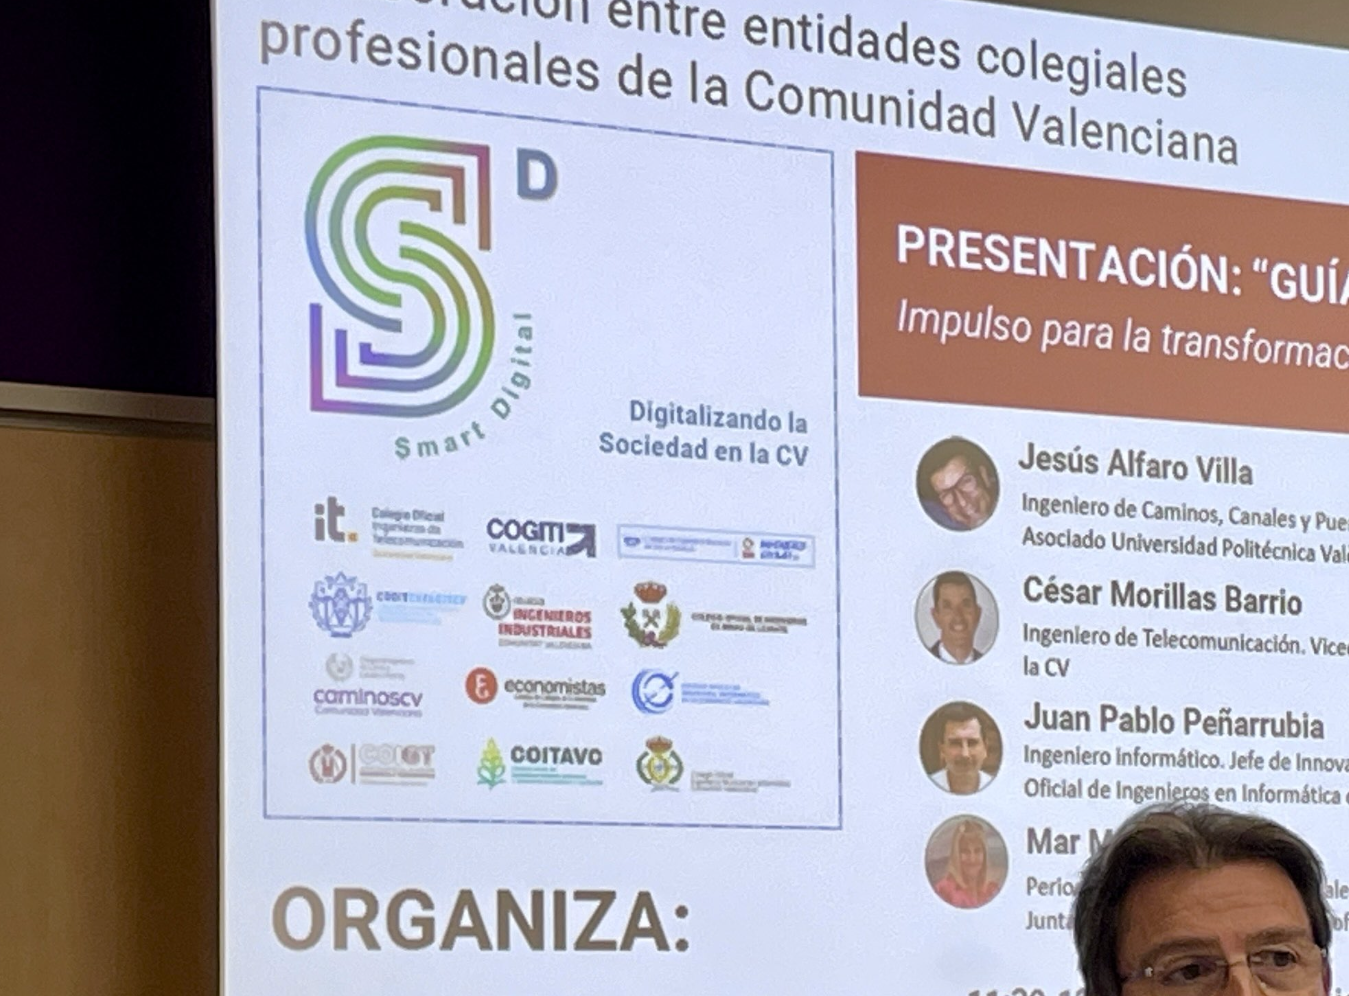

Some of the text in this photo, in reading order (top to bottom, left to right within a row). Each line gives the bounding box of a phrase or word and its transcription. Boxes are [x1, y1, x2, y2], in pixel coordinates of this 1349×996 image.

[607, 0, 727, 40] entre
[744, 13, 960, 70] entidades
[977, 38, 1186, 98] colegiales
[260, 18, 1238, 165] profesionales de la Comunidad Valenciana
[516, 147, 558, 201] D
[898, 224, 1241, 295] PRESENTACIÓN:
[898, 299, 1031, 344] Impulso
[1041, 320, 1113, 353] para
[1124, 317, 1150, 352] la
[394, 421, 486, 461] Smart
[490, 312, 534, 421] Digital
[630, 400, 807, 434] Digitalizando la
[599, 432, 809, 466] Sociedad en la CV
[1018, 442, 1253, 485] Jesús Alfaro Villa
[1022, 493, 1109, 517] Ingeniero
[1114, 498, 1137, 518] de
[1142, 501, 1223, 526] Caminos,
[1229, 506, 1296, 529] Canales
[1300, 515, 1311, 533] y
[1022, 526, 1106, 549] Asociado
[1112, 532, 1217, 556] Universidad
[1223, 538, 1316, 562] Politécnica
[1024, 575, 1302, 615] César Morillas Barrio
[499, 623, 592, 639] INDUSTRIALES
[513, 608, 591, 623] INGENIEROS
[1023, 623, 1110, 648] Ingeniero
[1115, 626, 1138, 647] de
[1142, 628, 1305, 655] Telecomunicación.
[1024, 656, 1070, 677] la CV
[313, 688, 423, 707] caminoscv
[504, 677, 606, 696] economistas
[1024, 702, 1324, 739] Juan Pablo Peñarrubia
[1024, 745, 1111, 769] Ingeniero
[1116, 747, 1225, 769] Informático.
[1229, 750, 1264, 770] Jefe
[1269, 751, 1291, 771] de
[1024, 777, 1082, 798] Oficial
[1088, 779, 1111, 799] de
[1116, 780, 1210, 804] Ingenieros
[1215, 786, 1237, 802] en
[1242, 783, 1340, 805] Informática
[1027, 827, 1081, 855] Mar
[272, 886, 689, 952] ORGANIZA:
